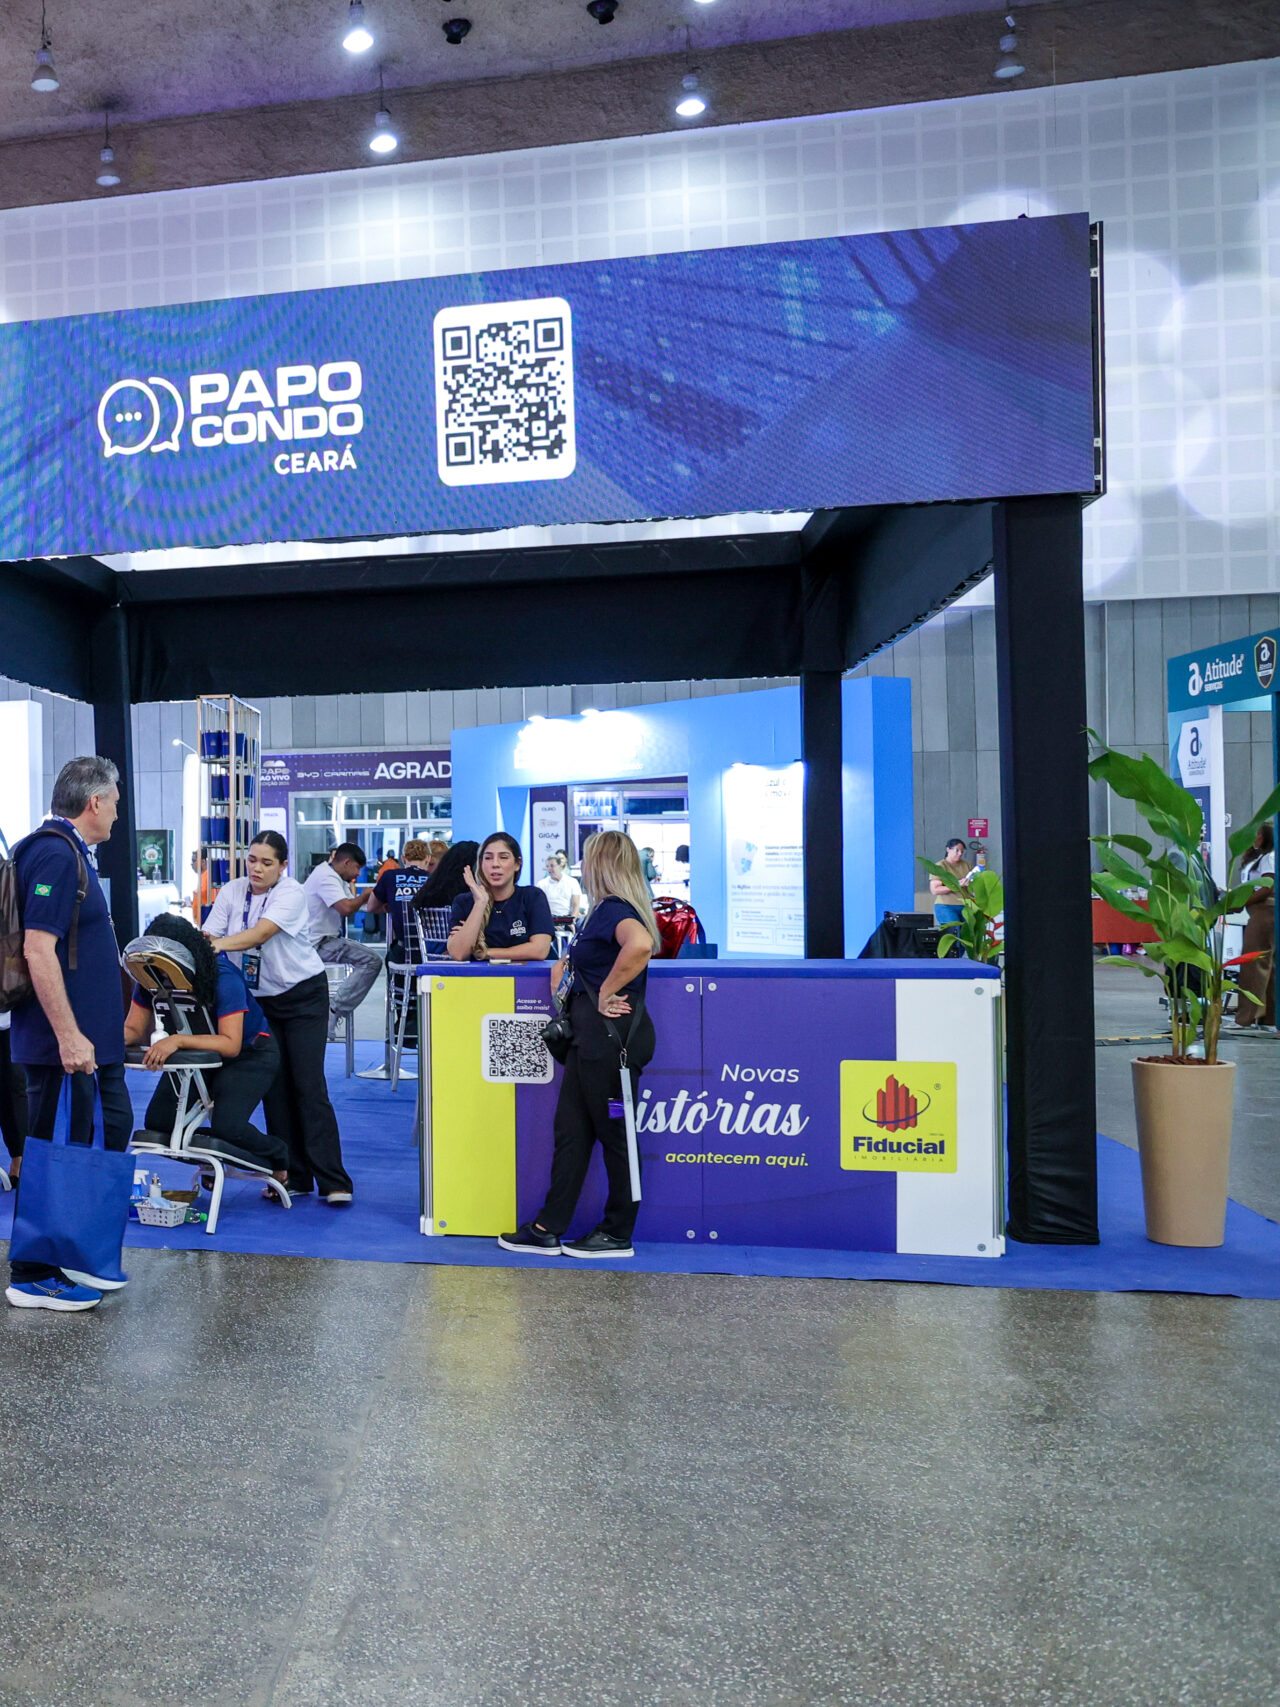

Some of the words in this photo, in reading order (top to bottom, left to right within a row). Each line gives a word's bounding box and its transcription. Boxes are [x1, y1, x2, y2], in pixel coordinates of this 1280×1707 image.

[189, 361, 362, 414] PAPO
[191, 403, 363, 447] CONDO
[274, 443, 357, 475] CEARÁ
[1204, 653, 1243, 681] Atitude
[374, 761, 452, 780] AGRAD
[721, 1064, 800, 1083] Novas
[635, 1089, 810, 1136] istórias
[853, 1136, 945, 1155] Fiducial
[665, 1151, 761, 1165] acontecem
[765, 1153, 809, 1169] aqui.
